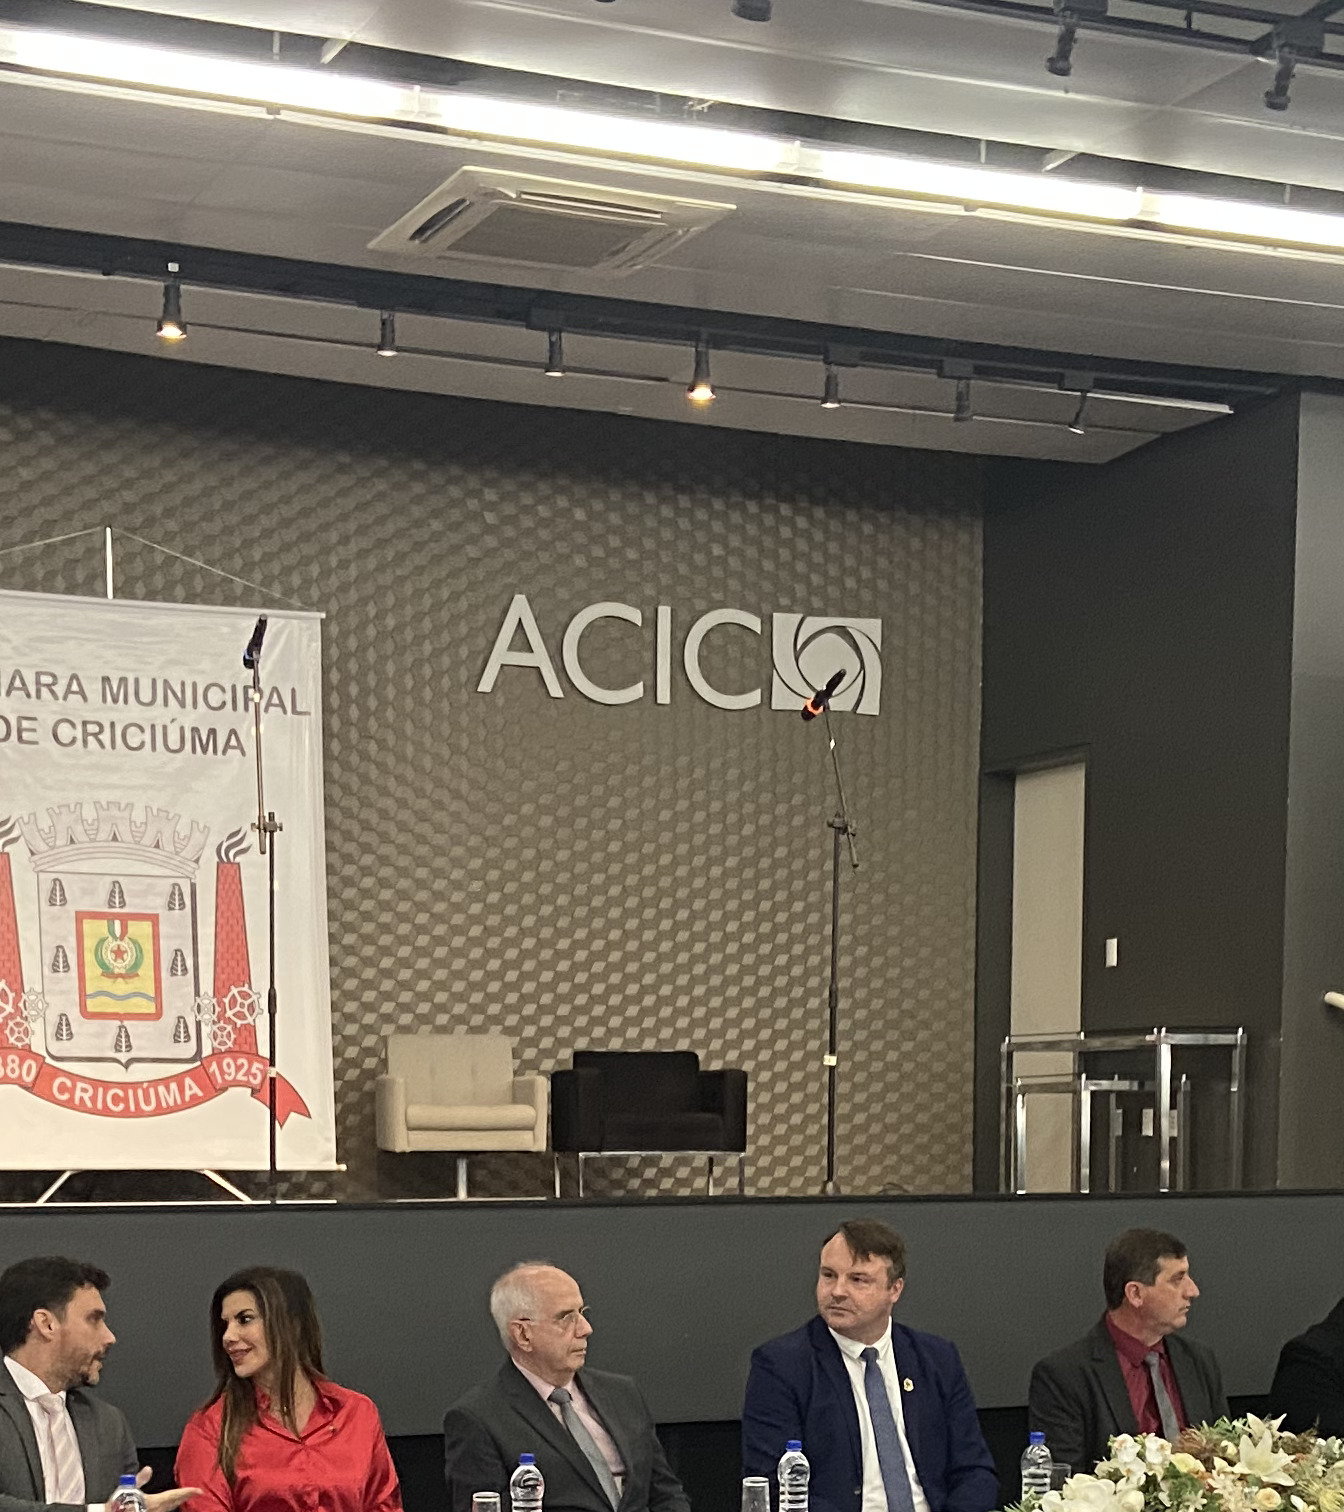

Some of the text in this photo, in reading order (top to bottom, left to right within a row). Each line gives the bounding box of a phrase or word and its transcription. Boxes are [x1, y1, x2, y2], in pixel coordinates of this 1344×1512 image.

[477, 593, 762, 710] ACIC
[100, 675, 311, 717] MUNICIPAL
[51, 717, 247, 758] CRICIÚMA
[208, 1056, 265, 1086] 1925
[51, 1075, 204, 1114] CRICIÚMA
